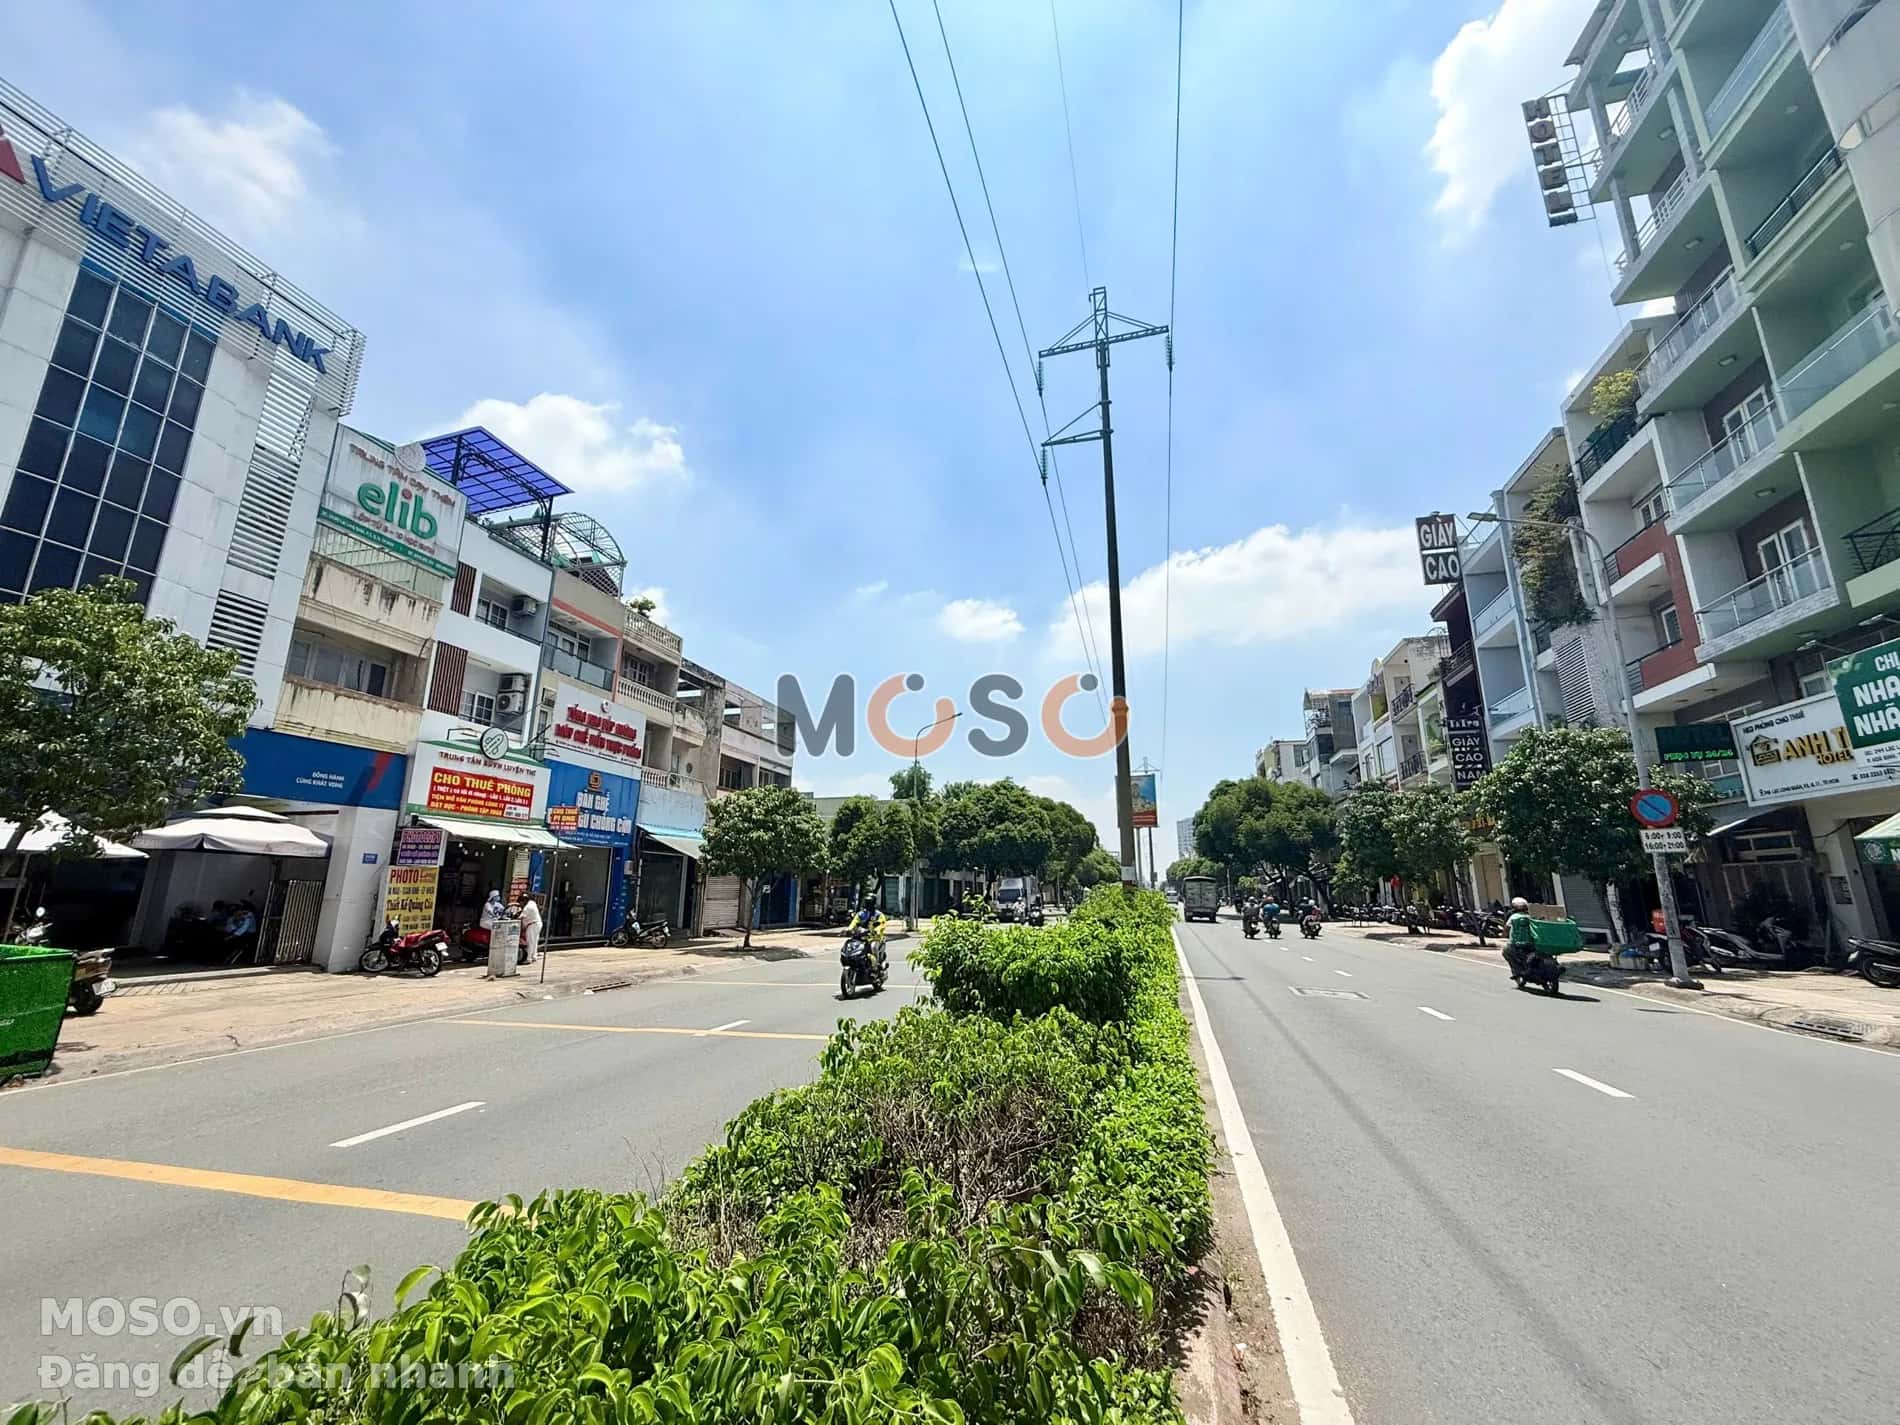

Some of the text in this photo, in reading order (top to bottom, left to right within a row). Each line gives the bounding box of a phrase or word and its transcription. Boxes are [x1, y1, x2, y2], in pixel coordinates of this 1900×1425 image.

[31, 155, 331, 374] VIETABANK
[357, 480, 438, 540] elib
[1420, 517, 1453, 547] GIÀY
[1425, 554, 1460, 580] CAO
[1452, 735, 1480, 746] GIÀY
[1783, 731, 1831, 760] ANH
[439, 752, 465, 763] TRUNG
[467, 755, 481, 766] TÂM
[1455, 753, 1484, 762] CAO
[434, 773, 460, 785] CHO
[464, 778, 494, 790] THUÊ
[498, 783, 531, 797] PHÒNG
[390, 869, 419, 884] PHOTO
